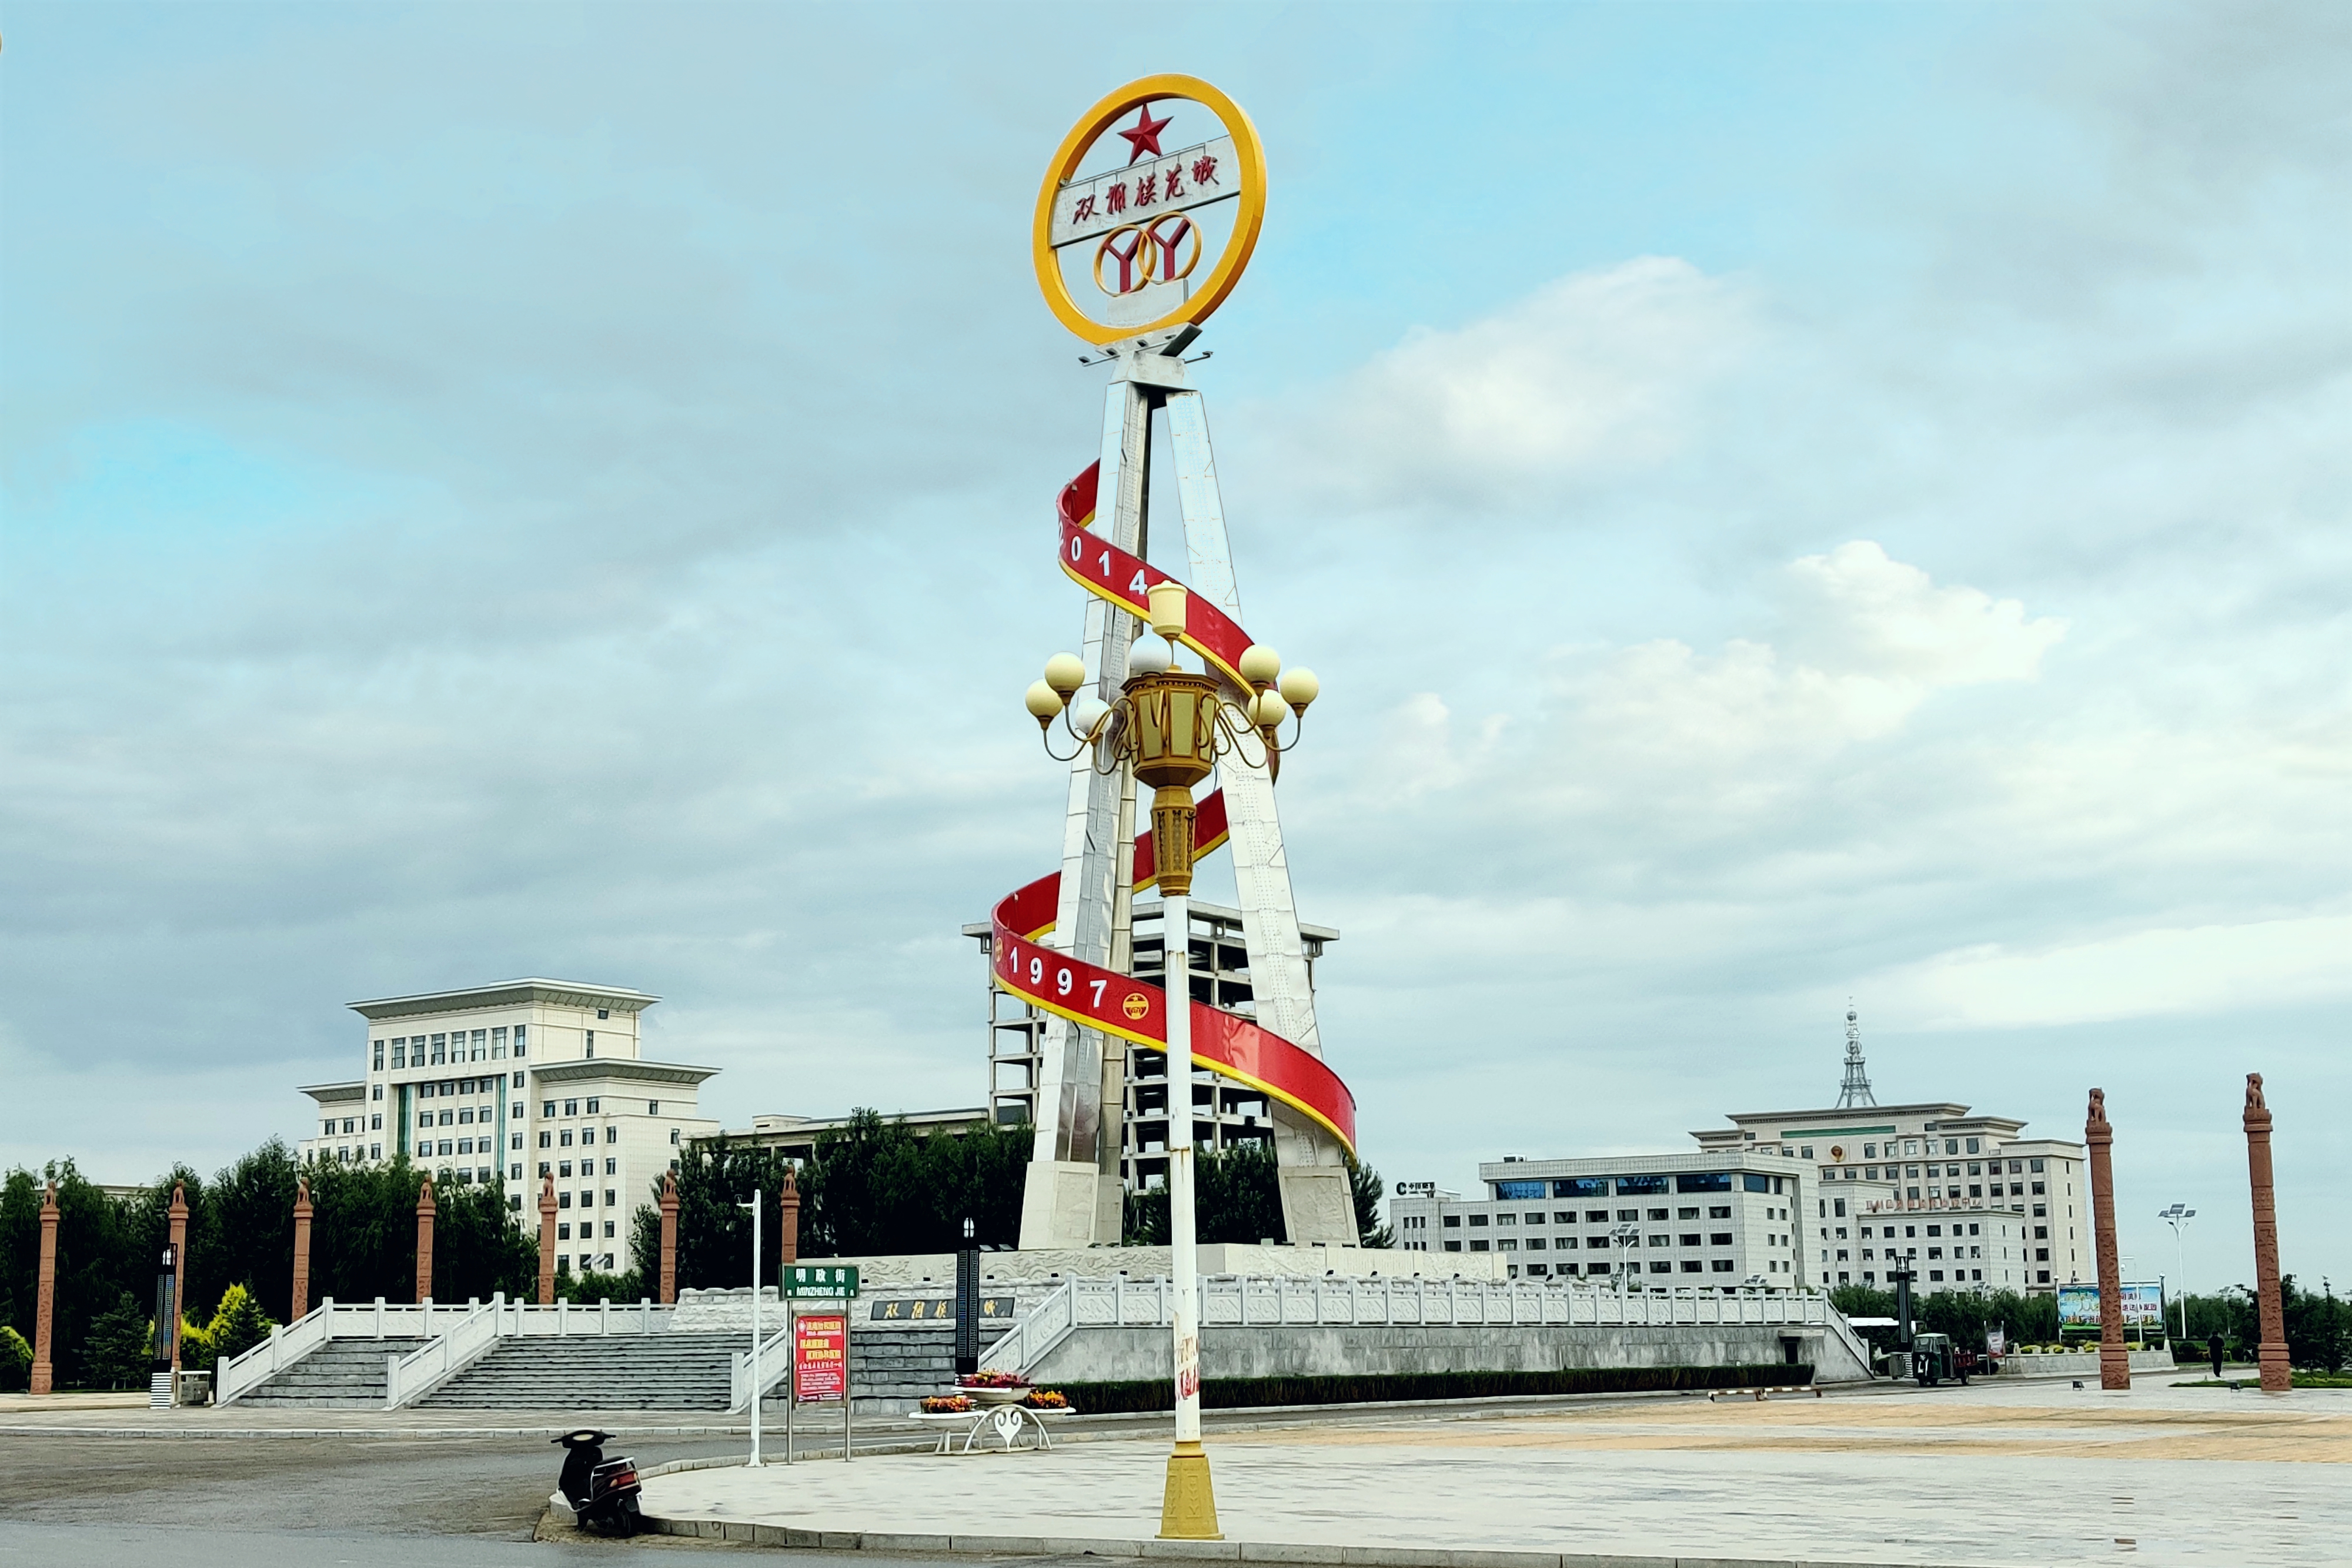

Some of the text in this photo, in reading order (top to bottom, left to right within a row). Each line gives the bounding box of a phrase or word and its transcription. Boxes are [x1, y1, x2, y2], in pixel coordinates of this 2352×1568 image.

[1010, 946, 1107, 1008] 1997
[883, 1299, 999, 1319] 双拥模城
